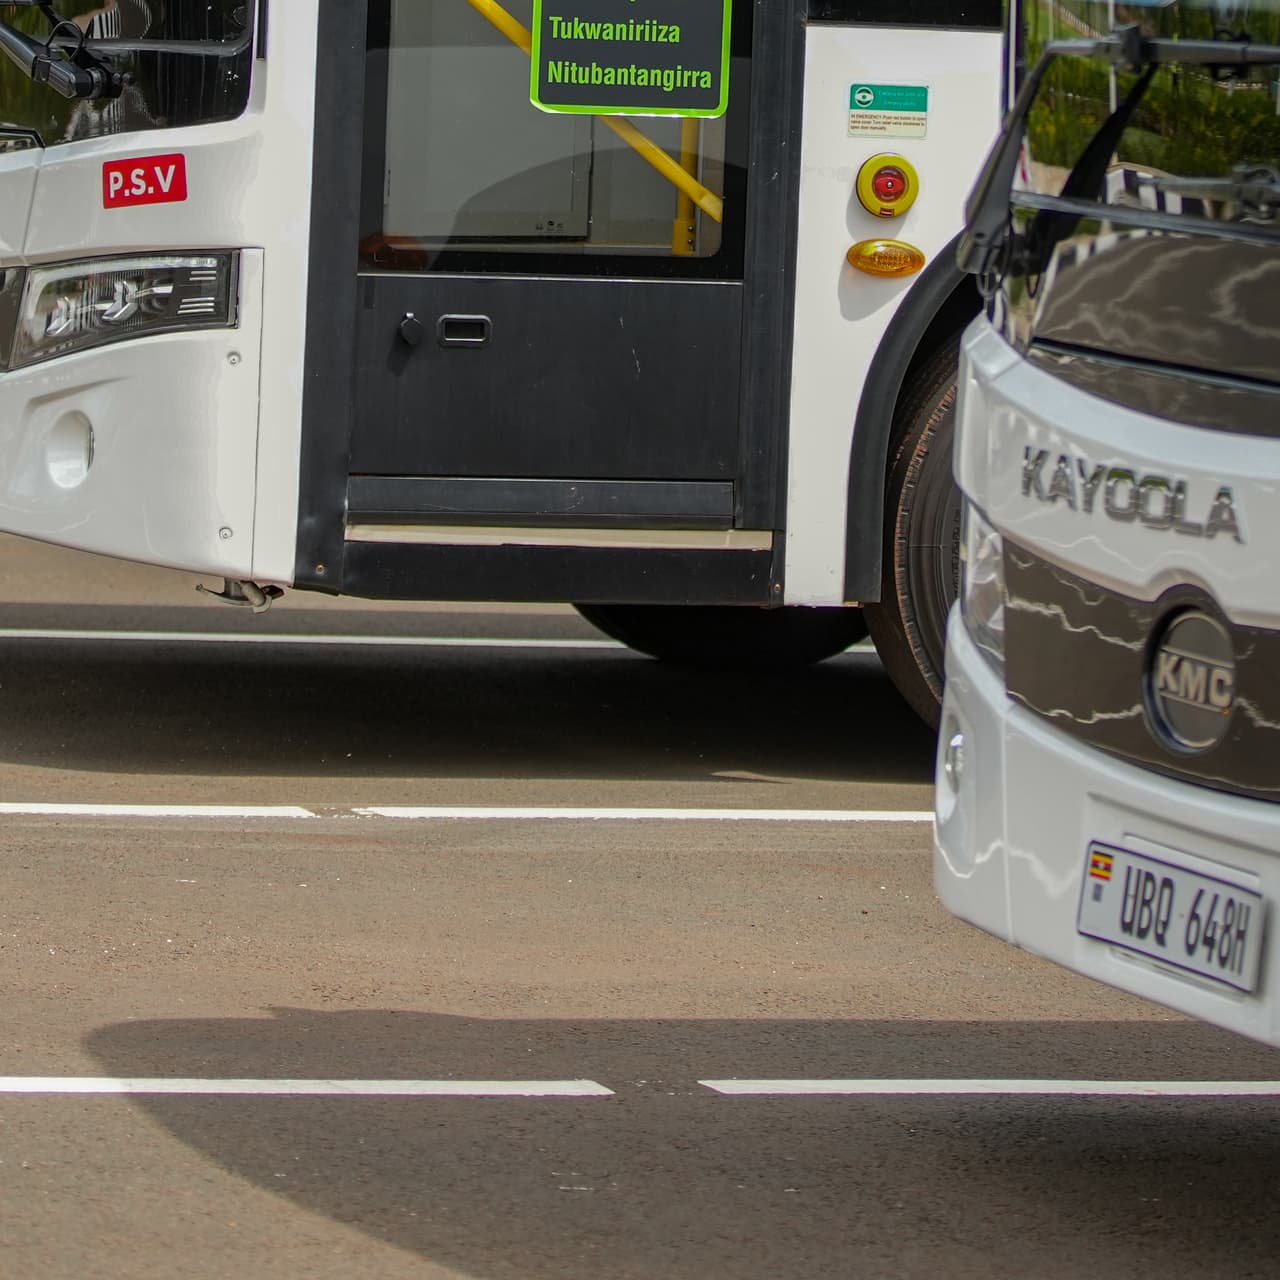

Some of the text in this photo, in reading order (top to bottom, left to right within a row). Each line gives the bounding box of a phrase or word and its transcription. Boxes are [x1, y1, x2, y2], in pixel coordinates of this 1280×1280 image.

[549, 16, 681, 44] Tukwaniriiza
[547, 60, 713, 93] Nitubantangirra
[108, 164, 176, 199] P.S.V
[1021, 445, 1246, 545] KAYOOLA
[1157, 651, 1234, 708] KMC
[1121, 865, 1252, 976] UBQ 648H
